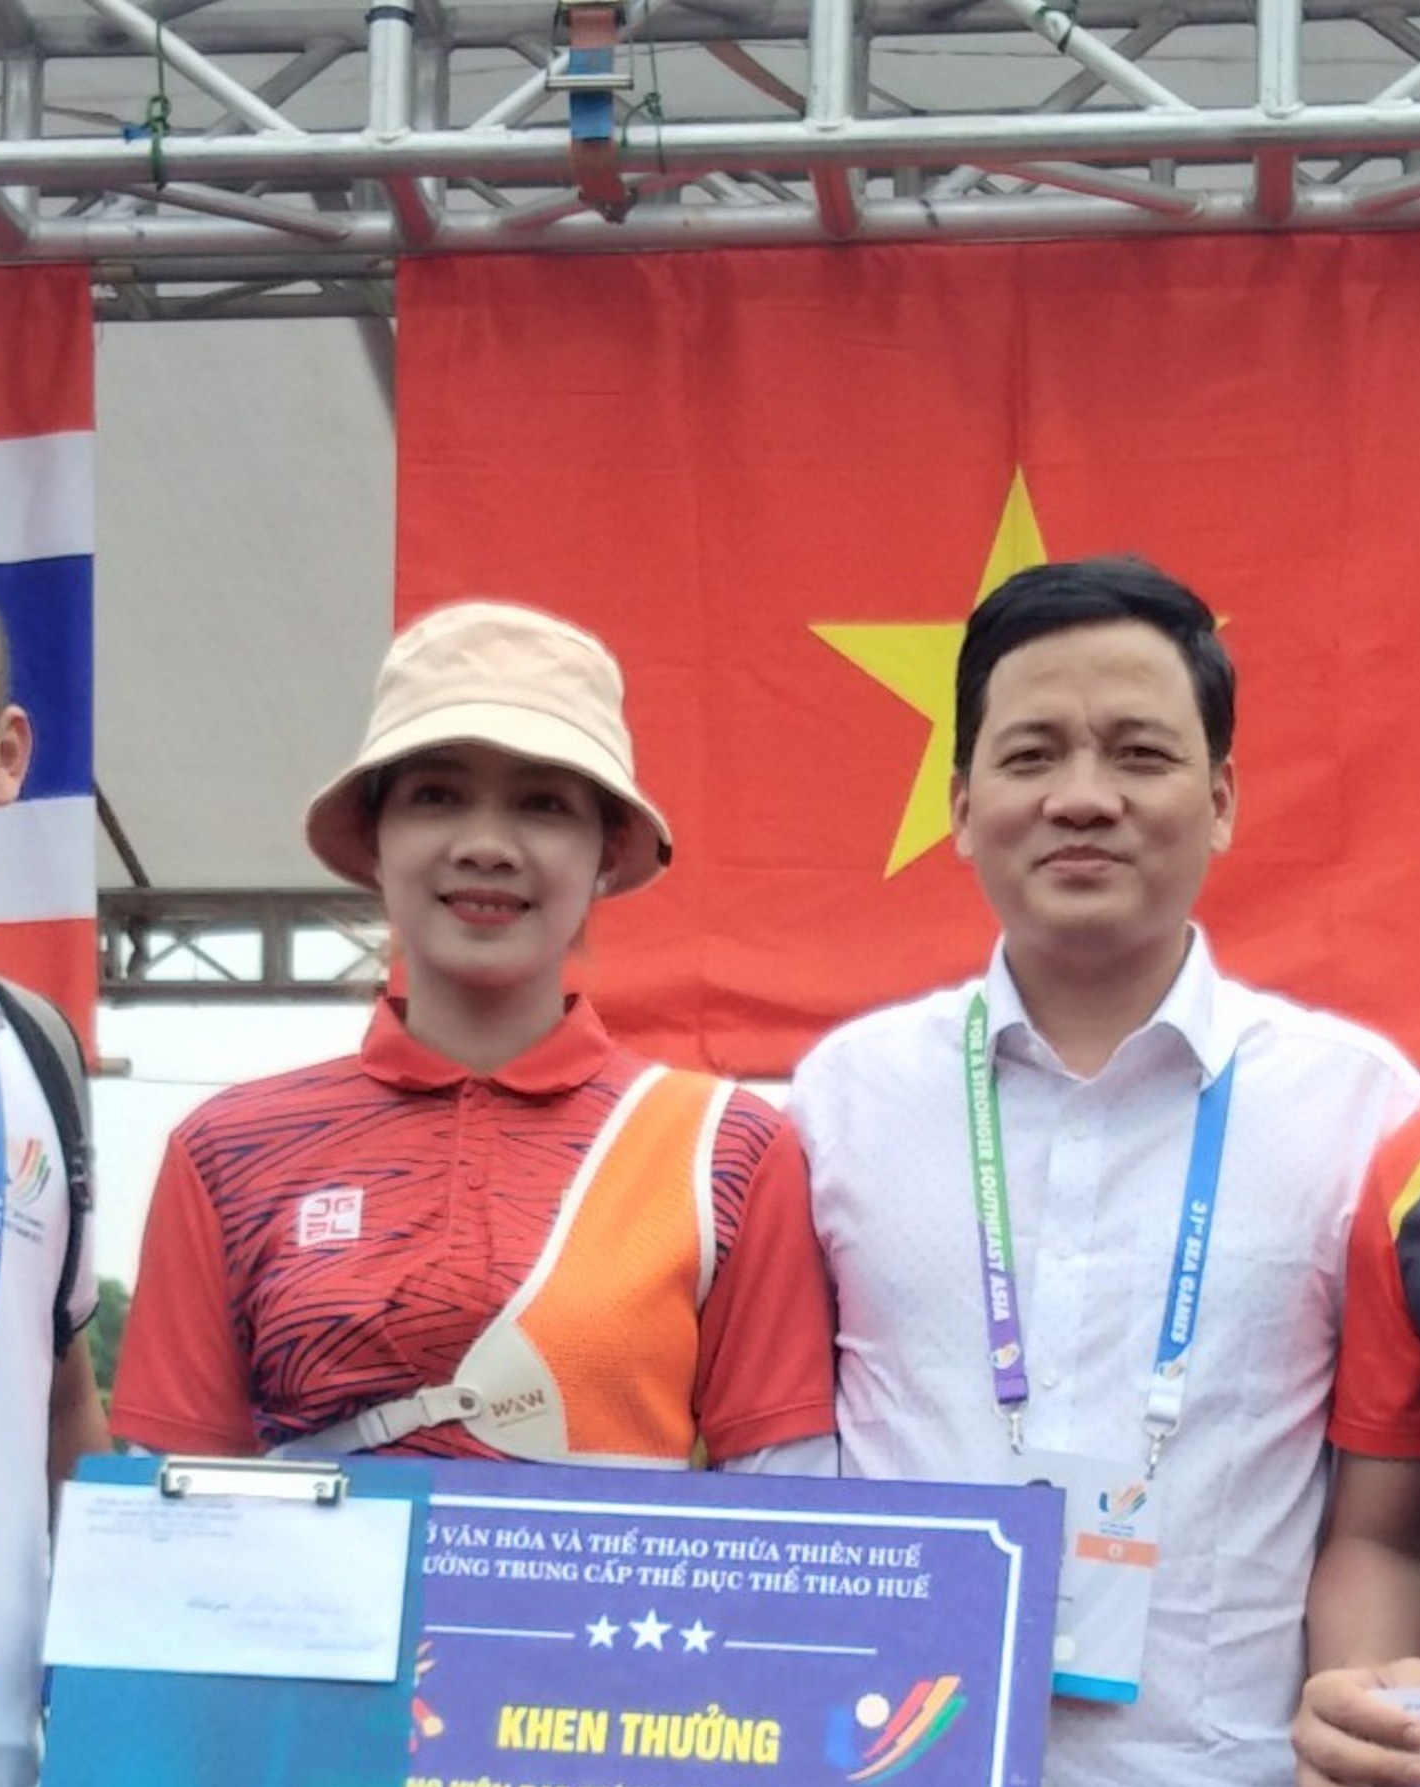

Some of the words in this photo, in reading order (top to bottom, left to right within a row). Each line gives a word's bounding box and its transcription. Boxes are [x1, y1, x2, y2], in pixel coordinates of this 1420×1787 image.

[969, 1017, 983, 1050] FOR
[971, 1069, 995, 1160] STRONGER
[979, 1164, 1005, 1273] SOUTHEAST
[989, 1273, 1011, 1322] ASIA
[1170, 1274, 1196, 1344] GAMES
[442, 1523, 490, 1547] VĂN
[495, 1526, 546, 1550] HÓA
[550, 1528, 583, 1552] VÀ
[588, 1527, 639, 1554] THỂ
[641, 1536, 708, 1558] THAO
[713, 1537, 779, 1561] THỪA
[784, 1540, 863, 1565] THIÊN
[867, 1542, 923, 1568] HUẾ
[422, 1553, 490, 1576] ƯỜNG
[494, 1558, 579, 1581] TRUNG
[583, 1559, 632, 1584] CẤP
[635, 1559, 688, 1587] THỂ
[691, 1569, 743, 1593] DỤC
[748, 1565, 801, 1593] THỂ
[803, 1573, 871, 1596] THAO
[876, 1573, 931, 1599] HUẾ
[497, 1705, 609, 1755] KHEN
[620, 1703, 781, 1764] THƯỞNG
